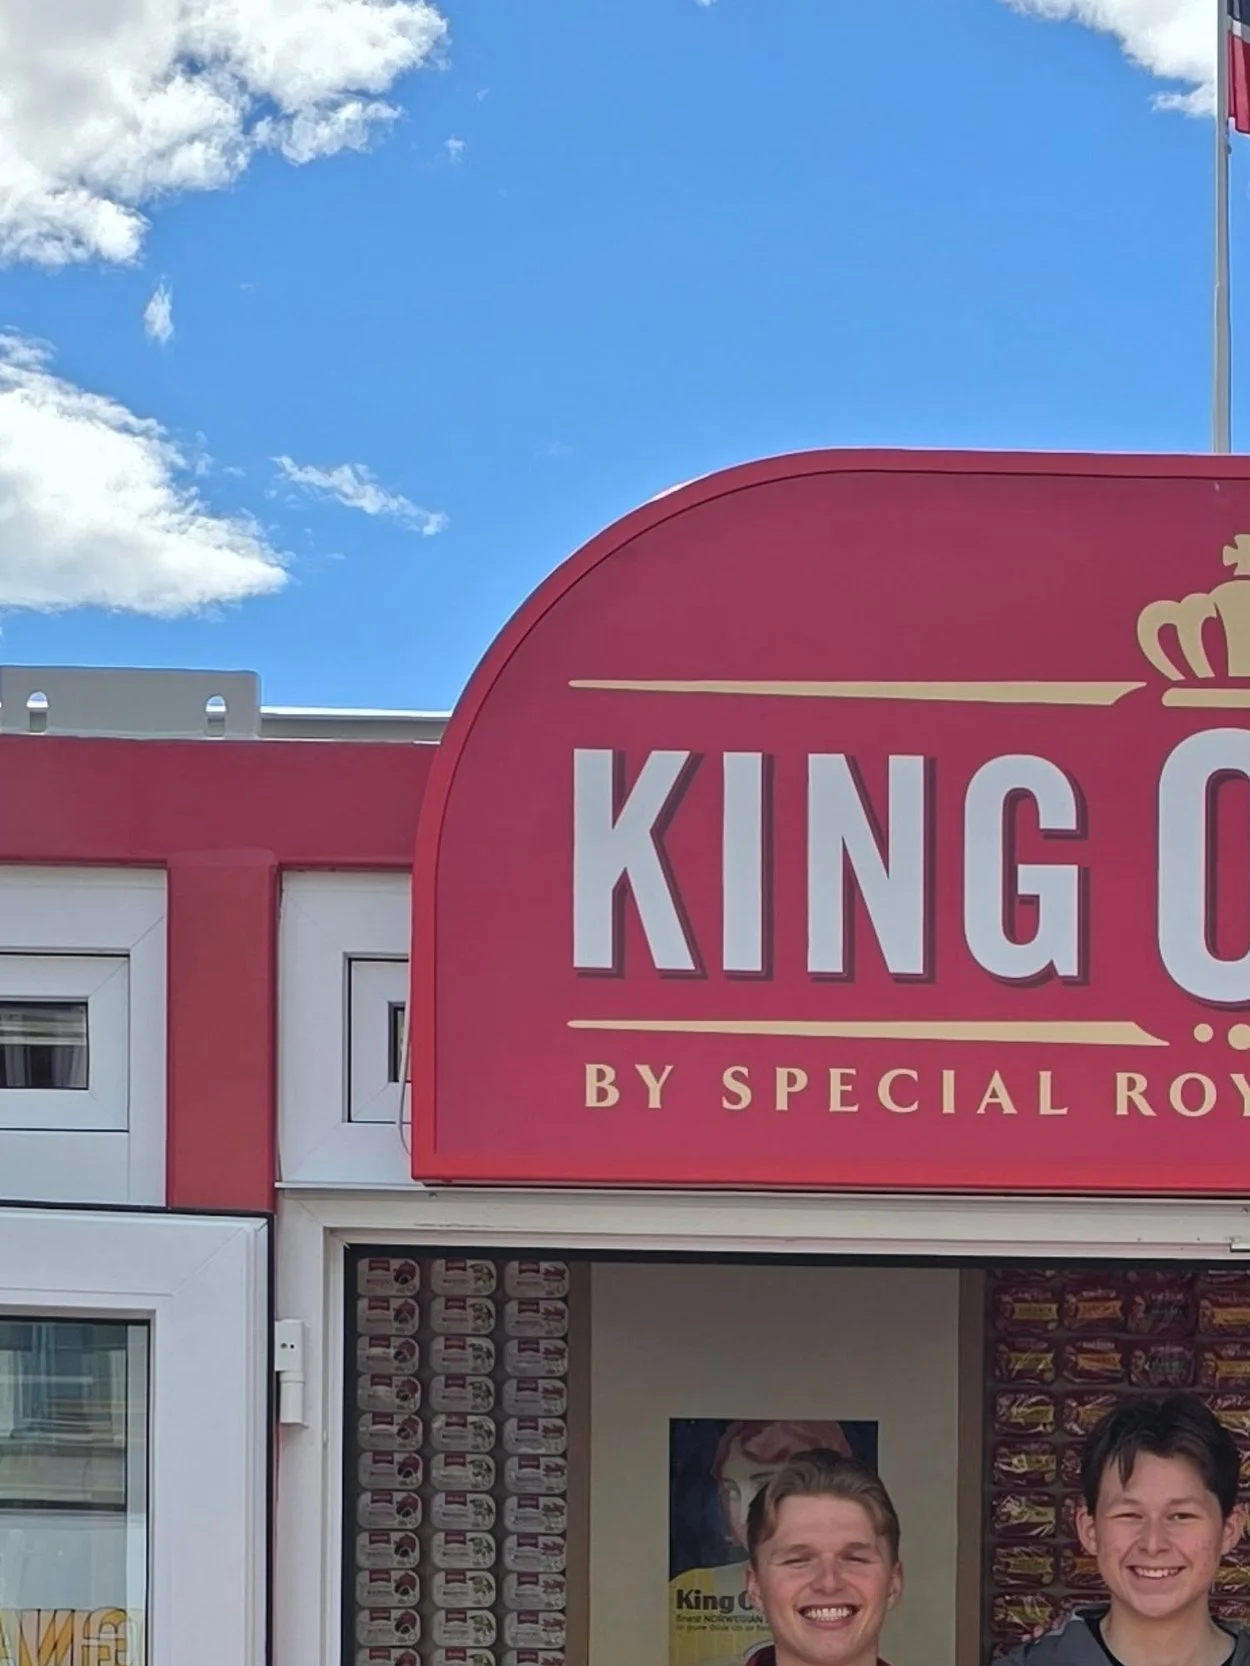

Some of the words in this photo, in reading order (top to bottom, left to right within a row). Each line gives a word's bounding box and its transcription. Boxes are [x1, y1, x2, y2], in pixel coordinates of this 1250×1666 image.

[573, 747, 1086, 983] KING
[584, 1063, 675, 1109] BY
[722, 1065, 1069, 1116] SPECIAL
[675, 1588, 735, 1614] King
